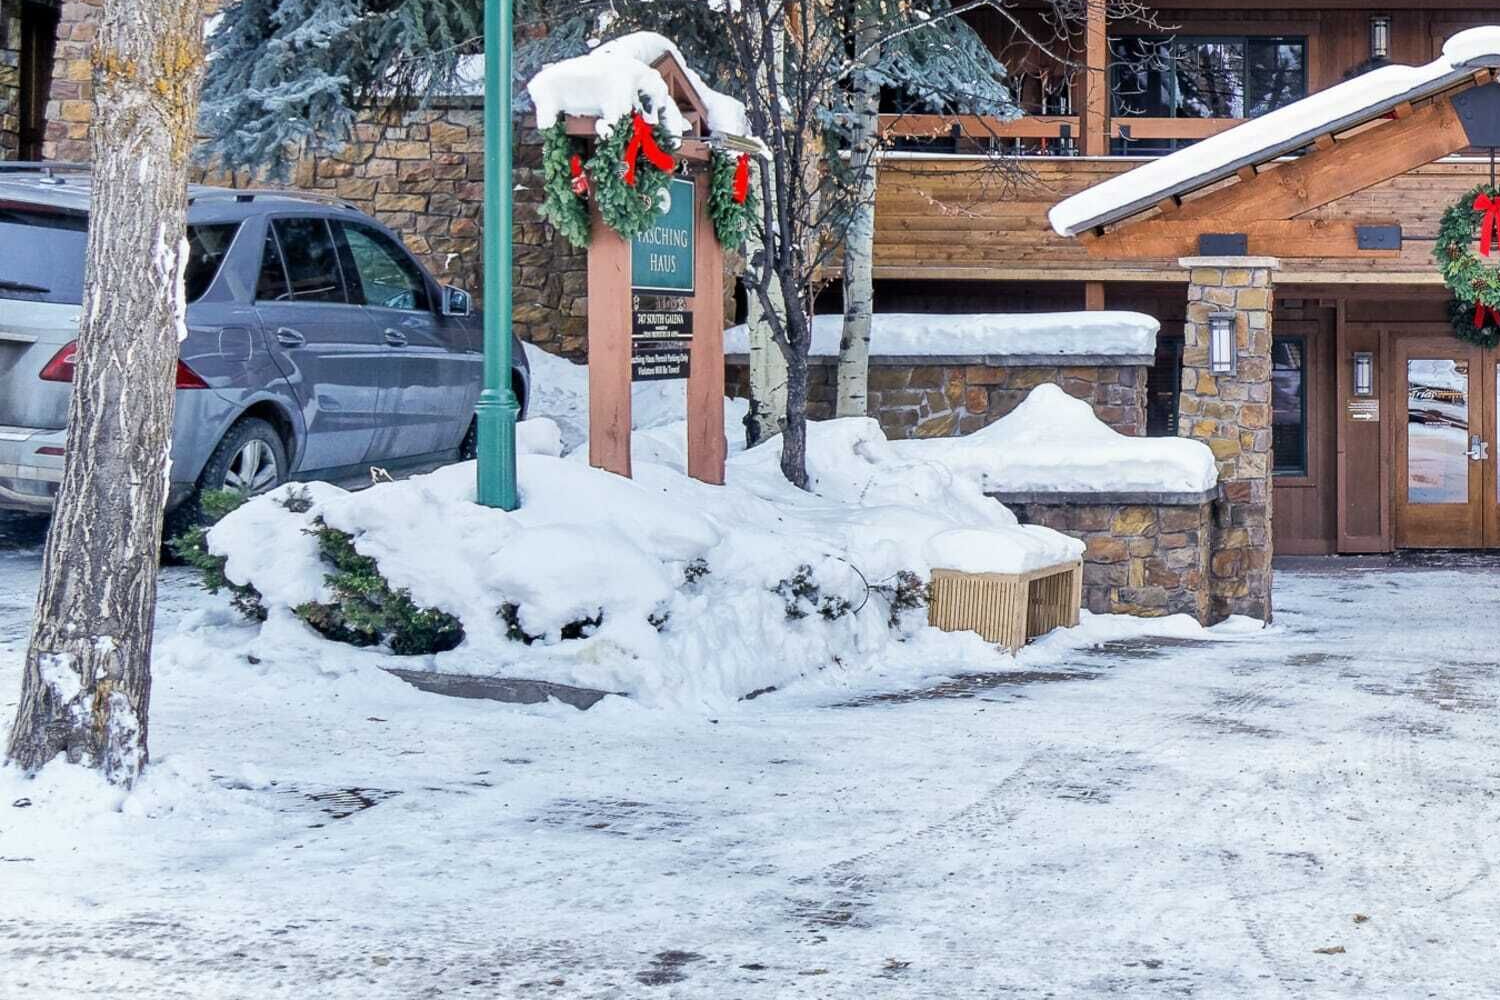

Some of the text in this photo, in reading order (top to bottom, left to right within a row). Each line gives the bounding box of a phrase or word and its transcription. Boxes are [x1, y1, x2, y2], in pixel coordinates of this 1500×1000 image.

[650, 253, 676, 273] HAUS
[647, 313, 665, 325] SOUTH
[665, 313, 684, 325] GALENA
